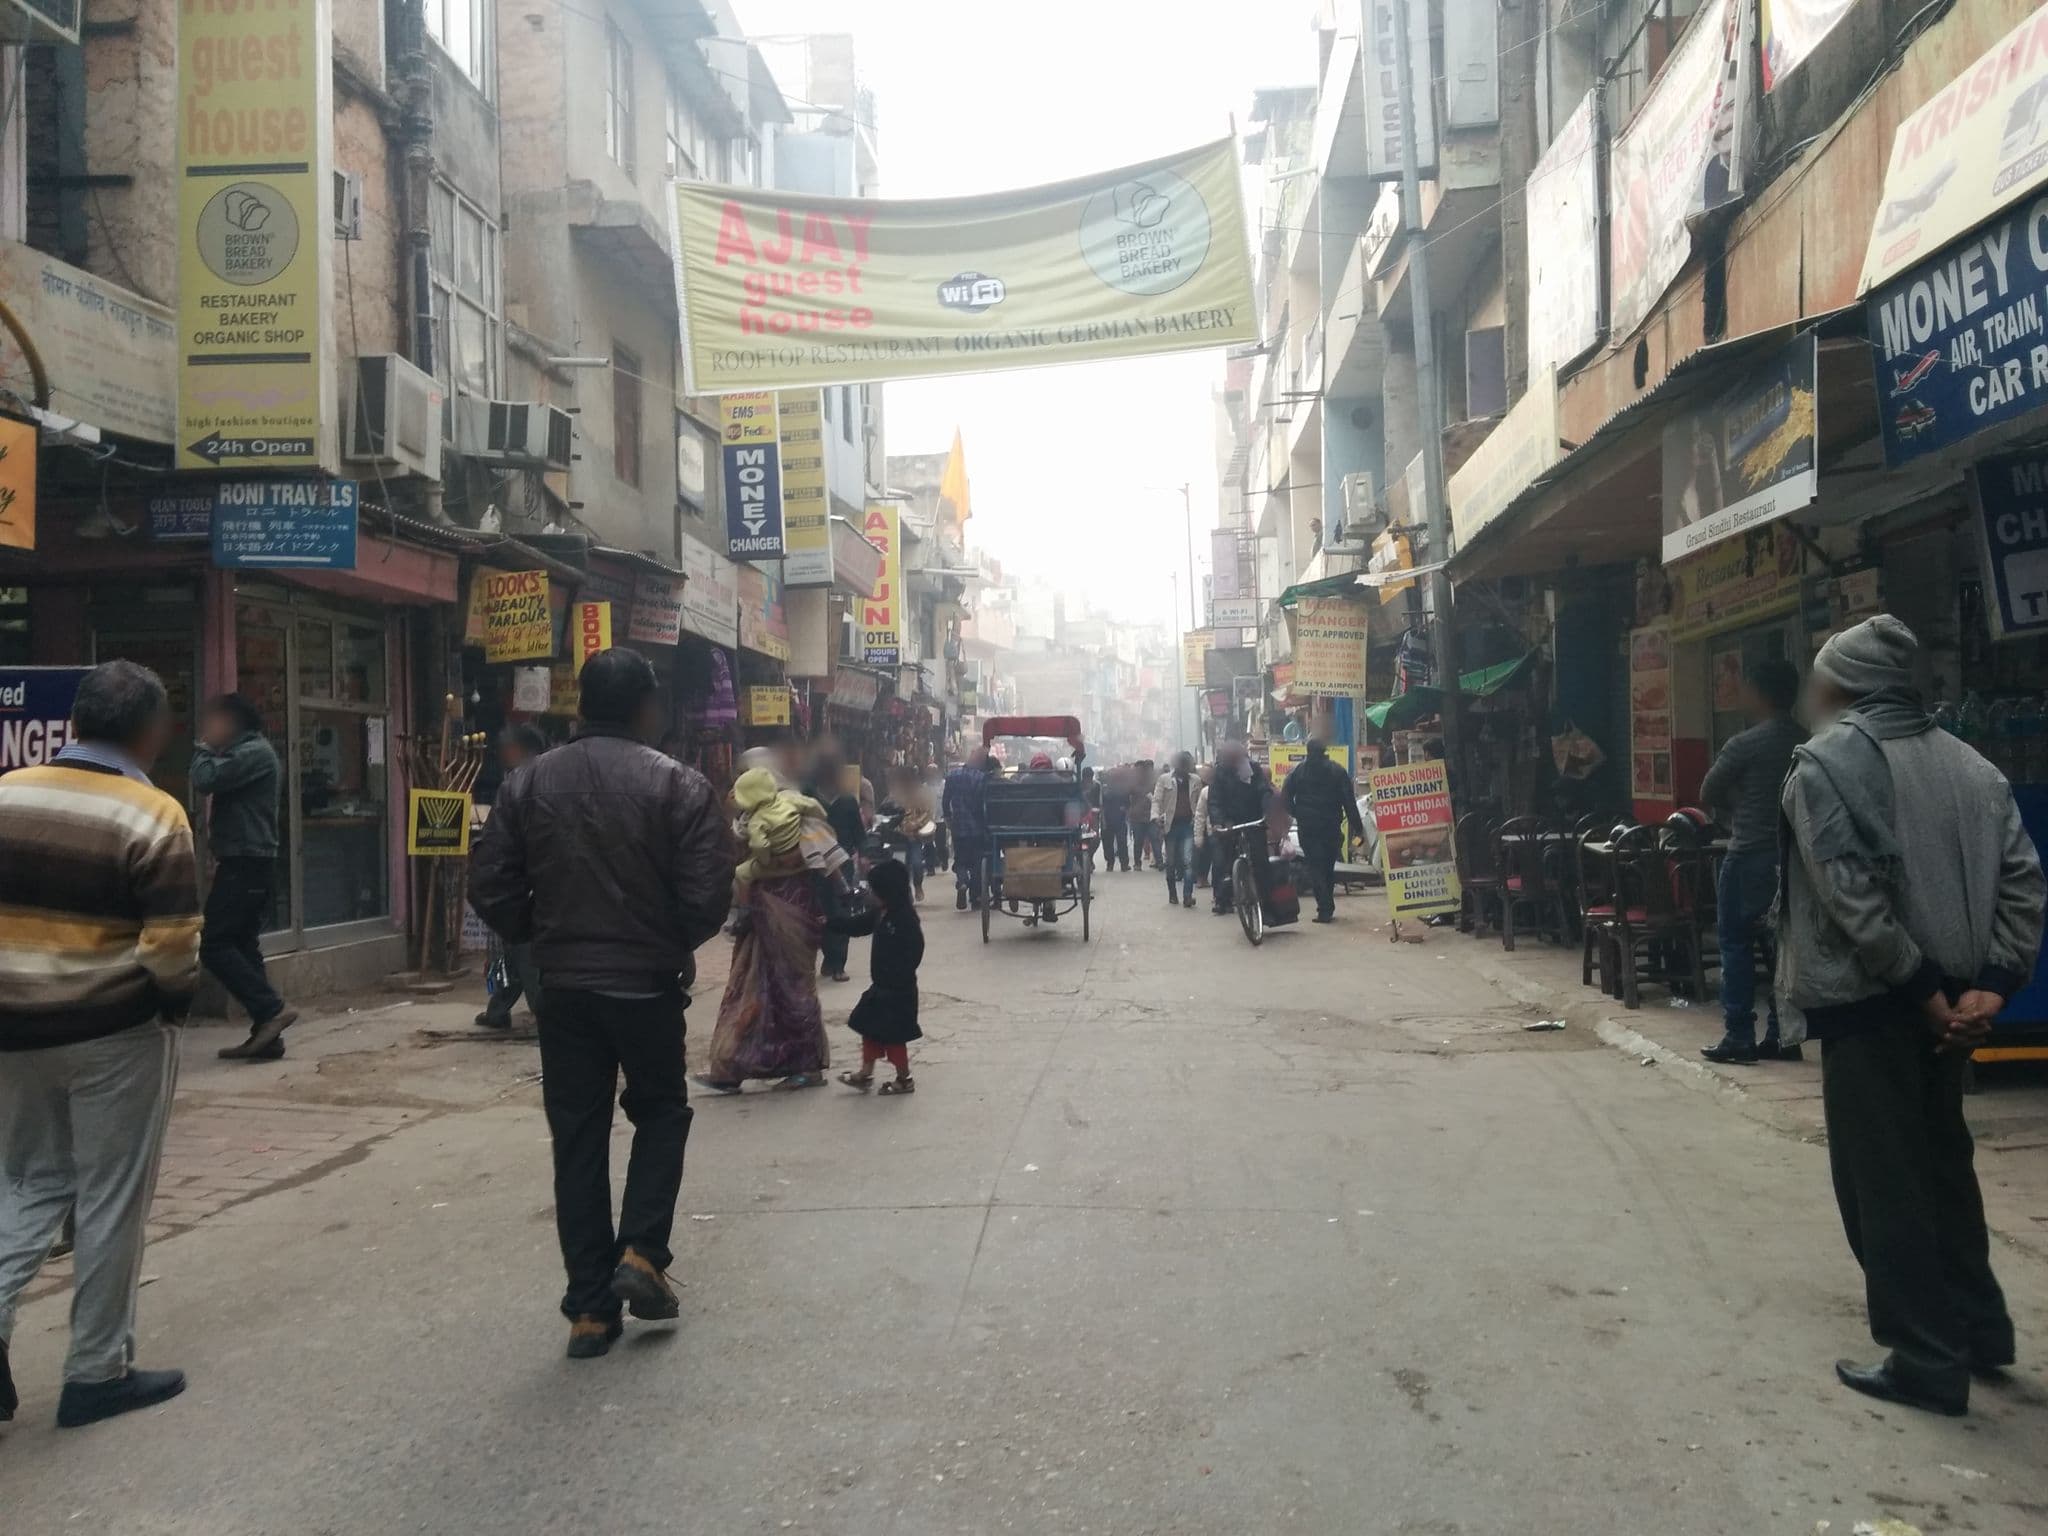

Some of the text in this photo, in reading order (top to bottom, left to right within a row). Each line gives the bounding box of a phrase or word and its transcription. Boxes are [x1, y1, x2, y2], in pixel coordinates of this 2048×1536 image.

[191, 24, 301, 96] guest
[187, 94, 307, 155] house
[225, 234, 270, 245] BROWN
[715, 200, 875, 265] AJAY
[1116, 230, 1173, 249] BROWN
[225, 246, 266, 258] BREAD
[1119, 245, 1172, 264] BREAD
[225, 257, 273, 270] BAKERY
[1121, 258, 1181, 280] BAKERY
[743, 265, 863, 307] guest
[1880, 222, 2011, 362] MONEY
[200, 293, 296, 308] RESTAURANT
[219, 312, 279, 326] BAKERY
[739, 307, 874, 335] house
[193, 329, 305, 345] ORGANIC SHOP
[712, 307, 1237, 371] ROOFTOP RESTAURANT ORGANIC GERMAN BAKERY
[1950, 293, 2043, 373] AIR, TRAIN,
[1969, 357, 2026, 417] CAR
[186, 415, 313, 428] high fashion boutique
[732, 405, 754, 419] EMS
[207, 439, 307, 456] 24h Open
[2011, 460, 2048, 497] M
[219, 483, 353, 508] RONI TRAVLS
[735, 448, 768, 537] MONEY
[1685, 499, 1776, 549] Grand Sindhi Restaurant
[730, 536, 781, 552] CHANGER
[493, 594, 545, 614] BEAUTY
[488, 610, 548, 629] PARLOUR
[1299, 615, 1367, 628] CHANGER
[864, 631, 899, 645] OTEL
[1297, 629, 1365, 640] GOVT. APPROVED
[867, 655, 889, 664] OPEN
[870, 648, 897, 657] HOURS
[1327, 682, 1364, 690] AIRPORT
[1373, 767, 1443, 787] GRAND SINDHI
[1376, 780, 1443, 801] RESTAURANT
[1376, 797, 1450, 817] SOUTH INDIAN
[1400, 813, 1429, 827] FOOD
[1388, 865, 1457, 882] BREAKFAST
[1404, 878, 1446, 890] LUNCH
[1404, 888, 1449, 901] DINNER
